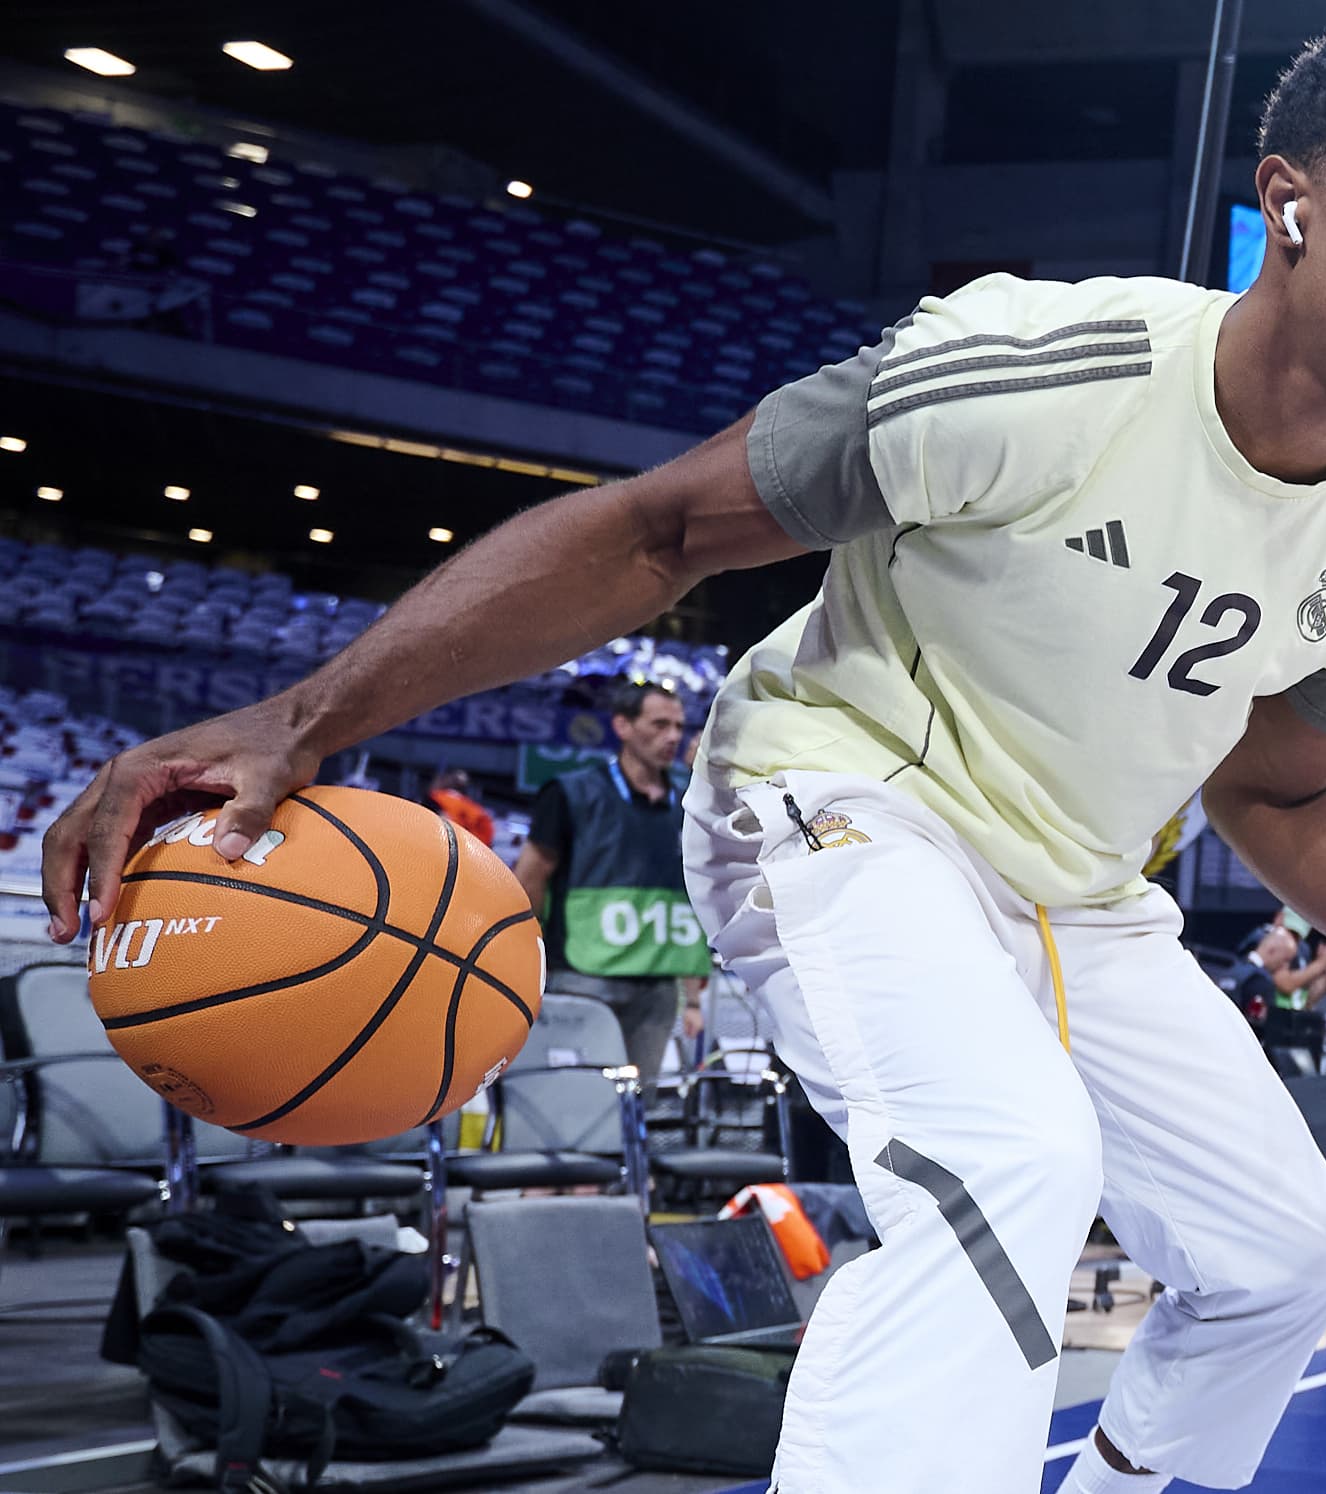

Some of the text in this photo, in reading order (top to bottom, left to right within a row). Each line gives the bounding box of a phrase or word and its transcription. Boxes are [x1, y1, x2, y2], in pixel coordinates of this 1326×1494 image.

[1128, 571, 1262, 697] 12
[88, 916, 223, 979] VO NXT
[600, 901, 701, 946] 015
